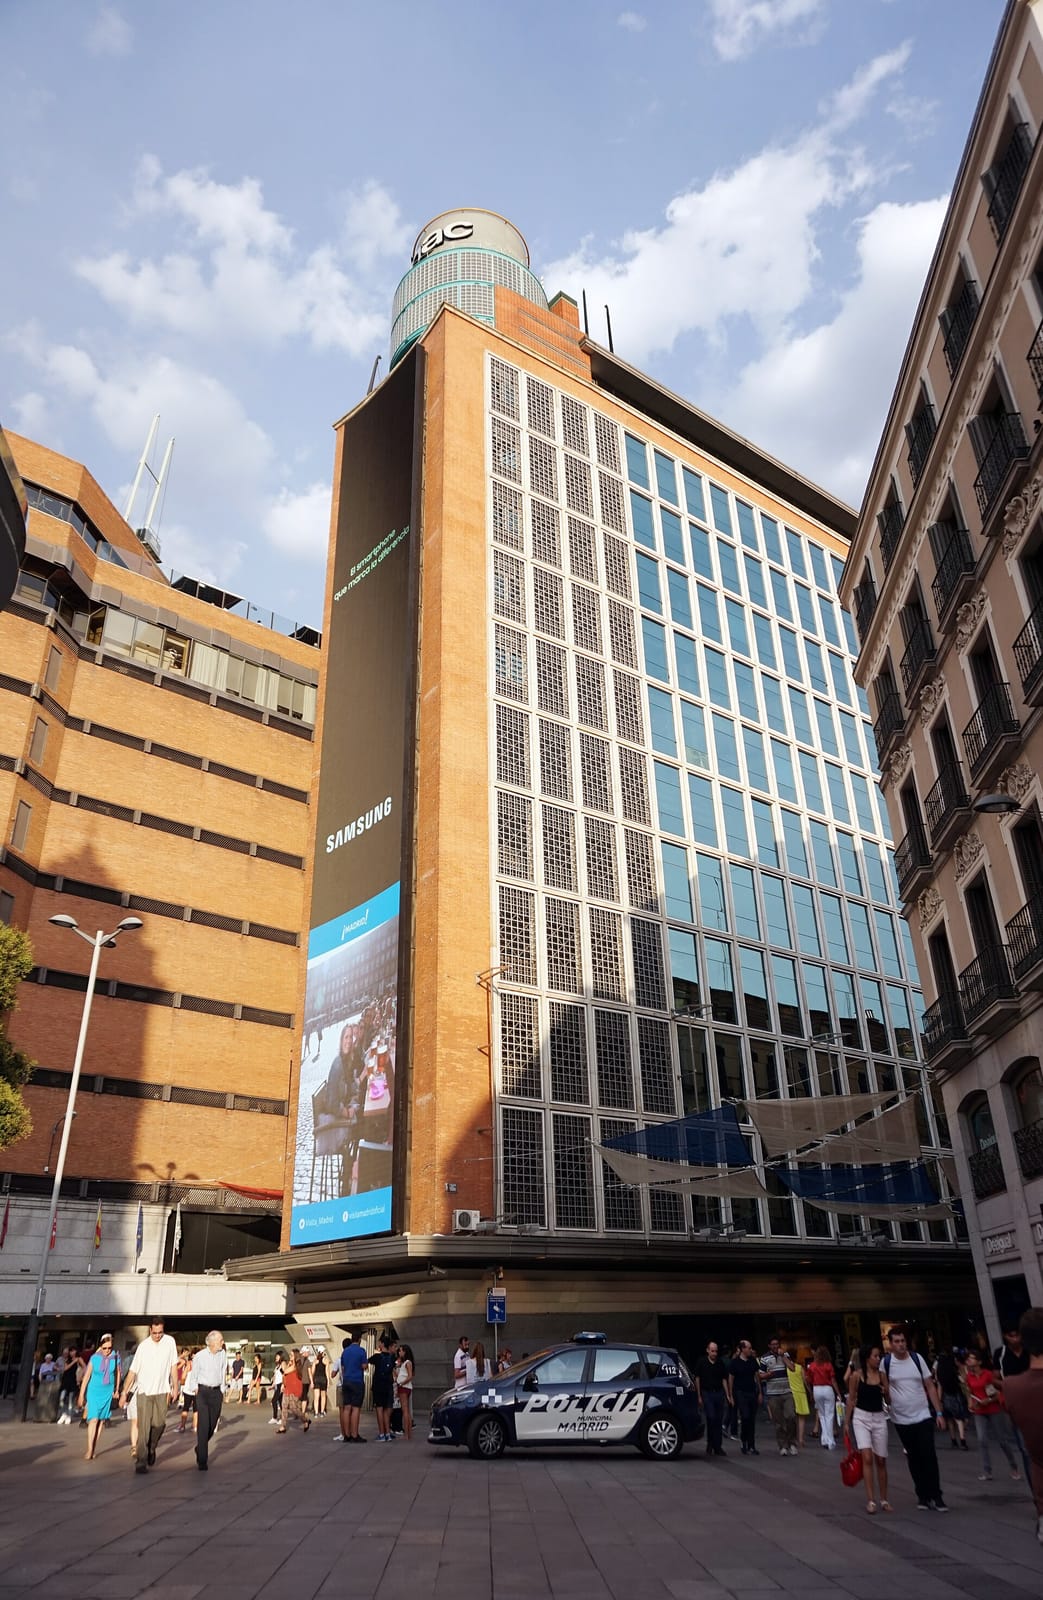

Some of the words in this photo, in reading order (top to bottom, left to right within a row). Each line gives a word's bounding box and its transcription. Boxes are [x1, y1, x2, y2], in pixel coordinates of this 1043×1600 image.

[333, 586, 348, 602] que
[348, 566, 371, 590] marca
[378, 525, 410, 562] diferencia
[356, 529, 395, 571] smartphone
[326, 796, 392, 854] SAMSUNG
[665, 1366, 677, 1375] 112
[557, 1422, 609, 1432] MADRID
